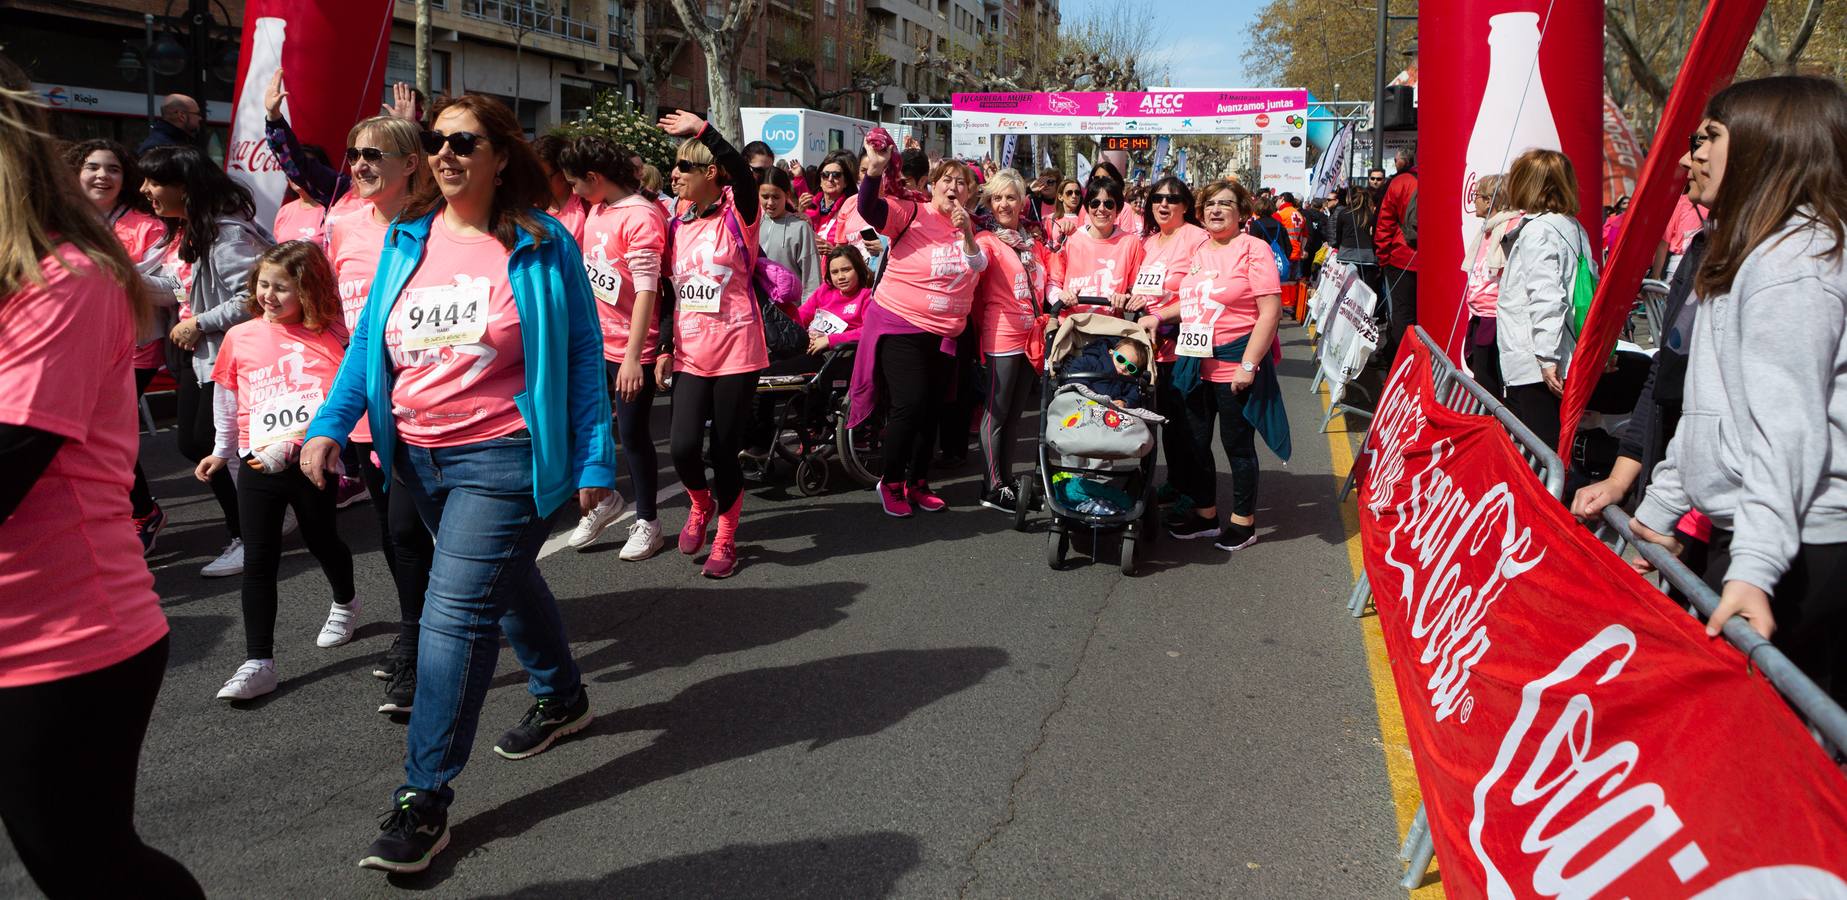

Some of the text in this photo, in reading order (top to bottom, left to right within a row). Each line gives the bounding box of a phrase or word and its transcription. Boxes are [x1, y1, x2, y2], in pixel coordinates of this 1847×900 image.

[74, 94, 98, 105] Rioja
[1139, 94, 1184, 108] AECC
[1217, 99, 1294, 113] Avanzamos juntas
[998, 117, 1027, 127] Ferrer
[766, 130, 795, 141] uno
[1069, 276, 1091, 288] HOY
[1138, 273, 1161, 286] 2722
[680, 285, 715, 300] 6040
[409, 300, 477, 330] 9444
[1181, 332, 1208, 347] 7850
[263, 405, 309, 432] 906
